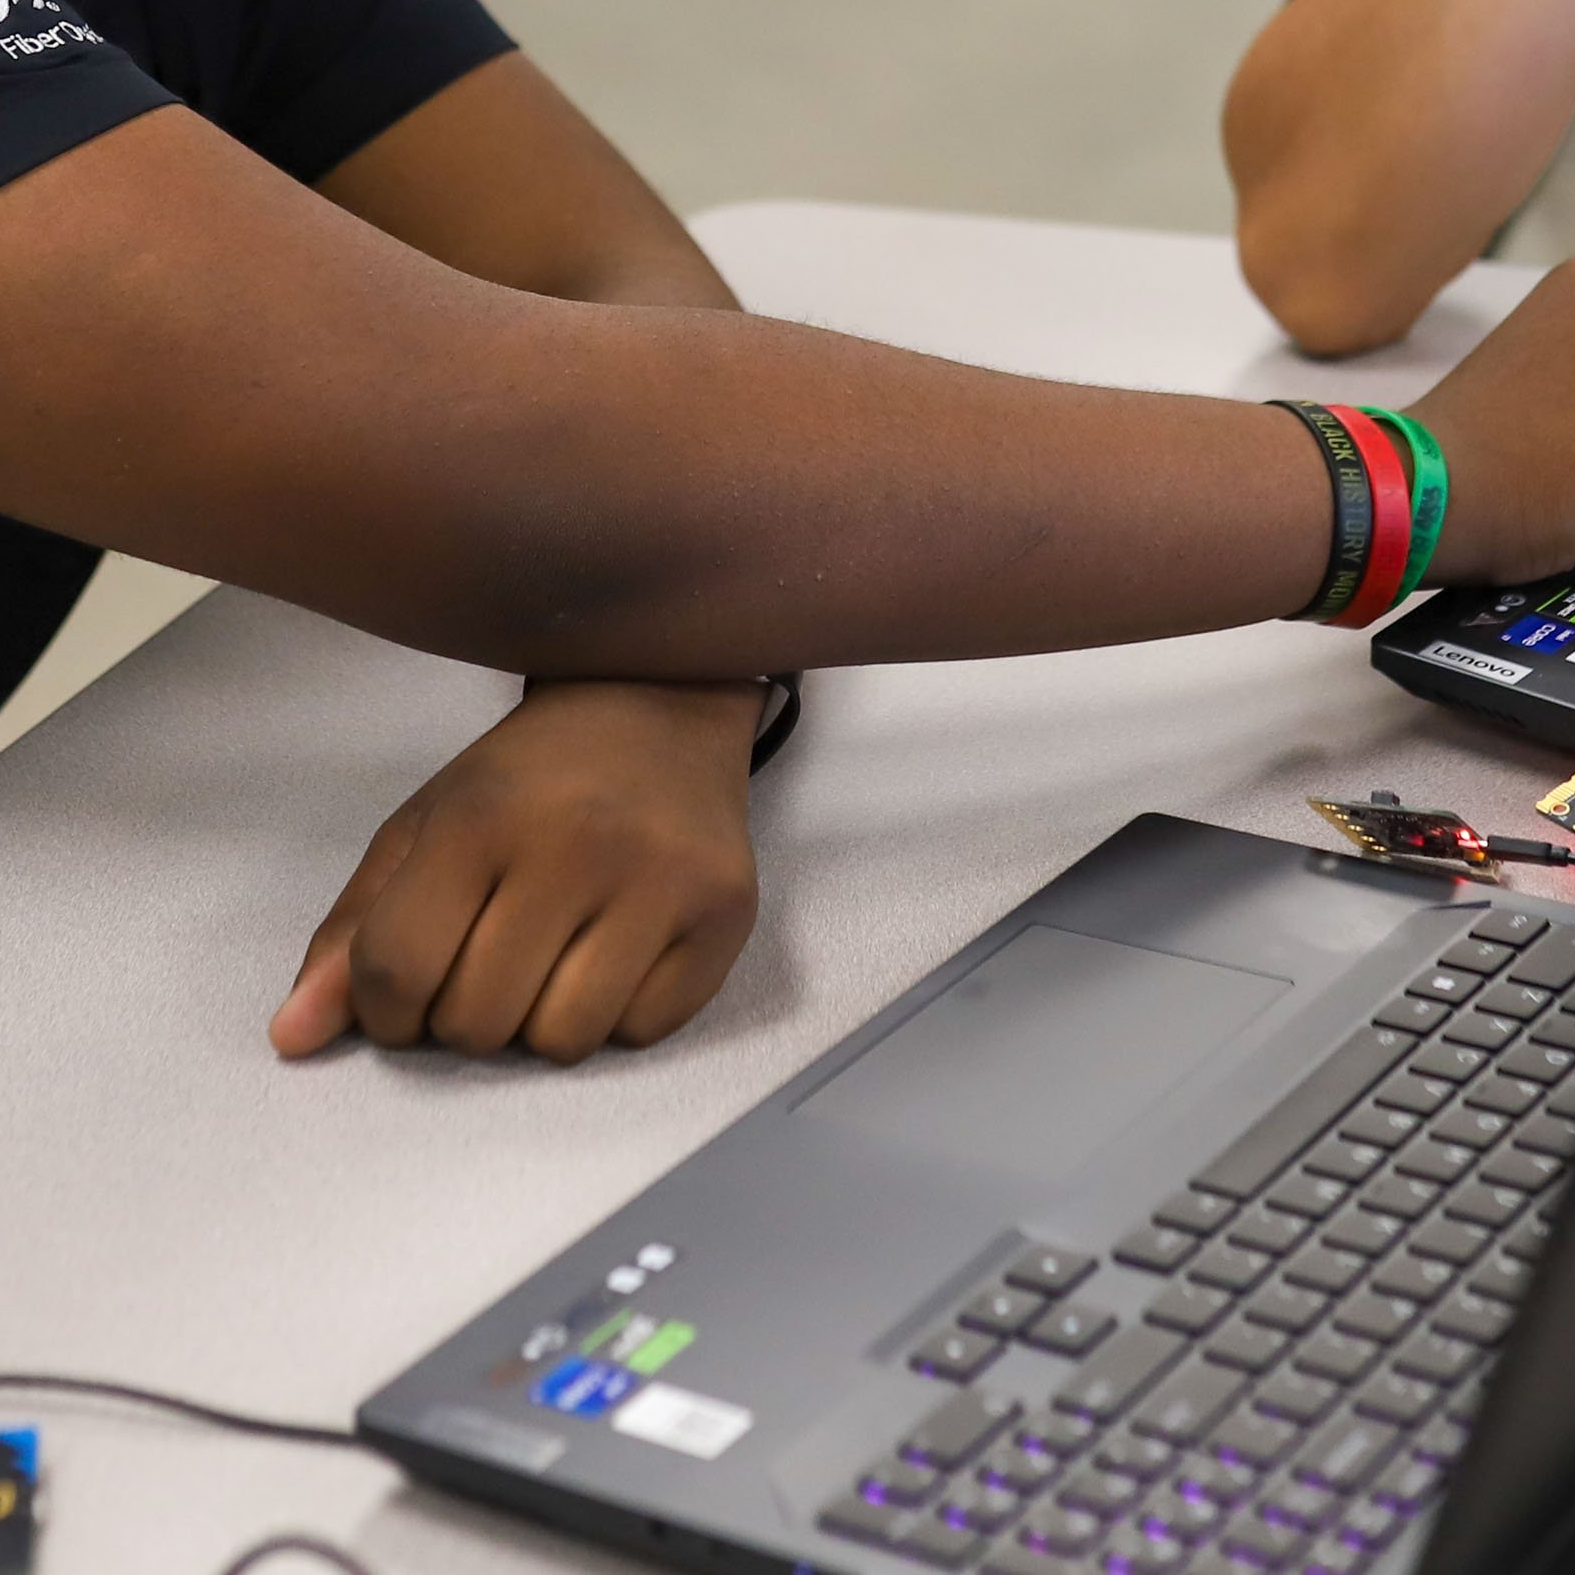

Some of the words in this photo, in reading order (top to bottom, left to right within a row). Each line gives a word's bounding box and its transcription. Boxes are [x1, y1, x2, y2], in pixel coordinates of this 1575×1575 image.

[1309, 413, 1354, 462] BLACK
[1338, 467, 1368, 564] HISTORY
[1432, 645, 1516, 677] Lenovo
